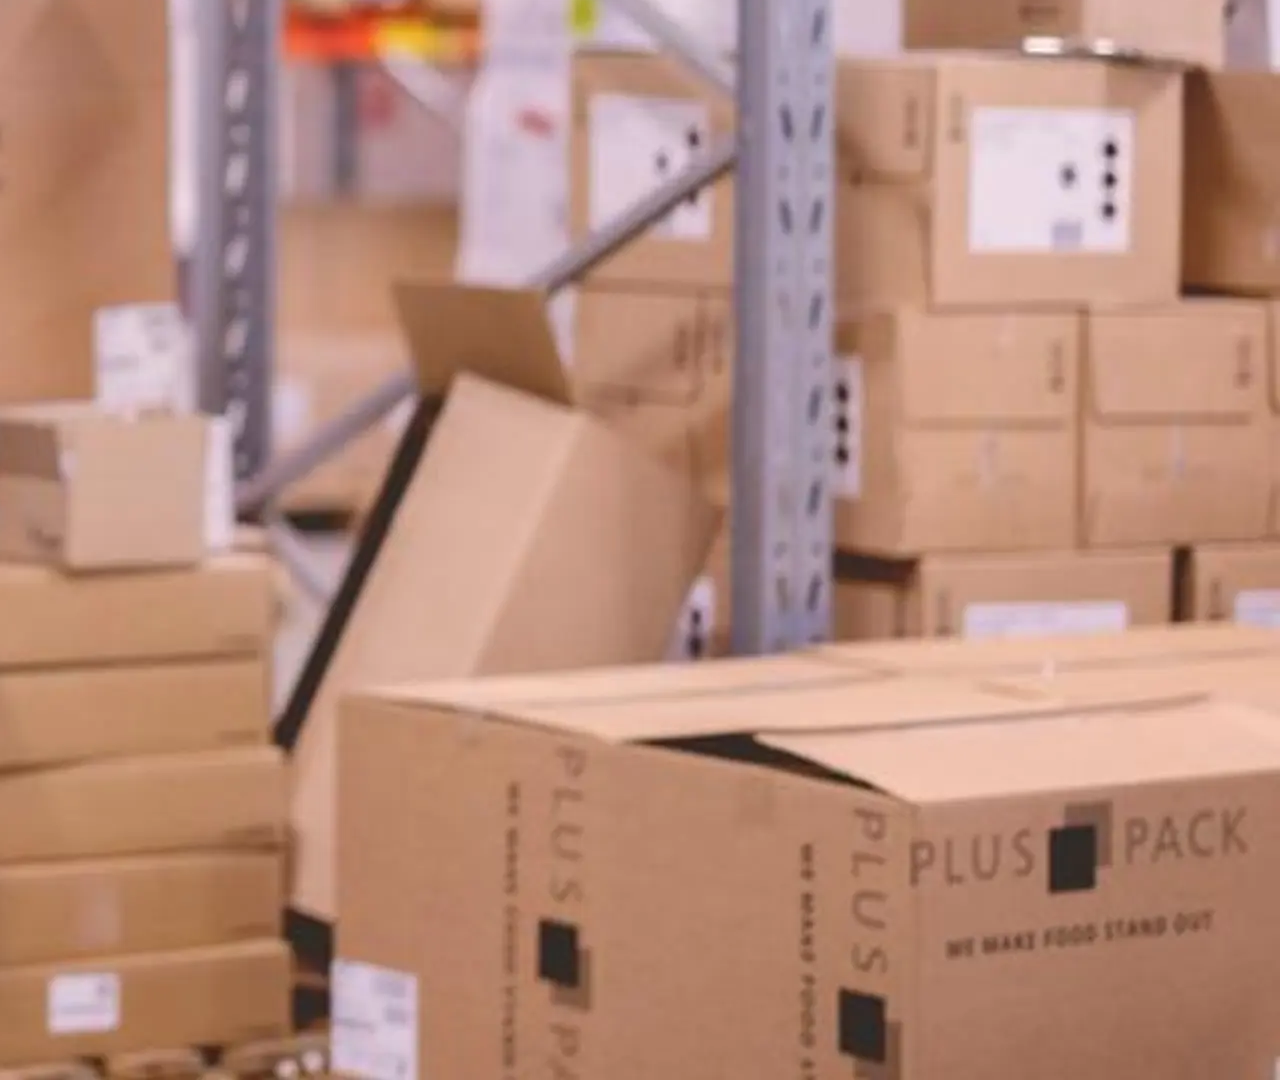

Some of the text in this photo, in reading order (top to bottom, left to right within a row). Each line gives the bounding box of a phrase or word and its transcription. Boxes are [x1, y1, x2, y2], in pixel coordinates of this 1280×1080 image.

[550, 745, 587, 904] PLUS
[908, 807, 1249, 888] PLUS PACK
[849, 806, 889, 974] PLUS
[945, 908, 1216, 959] WE MAKE FOOD STAND OUT
